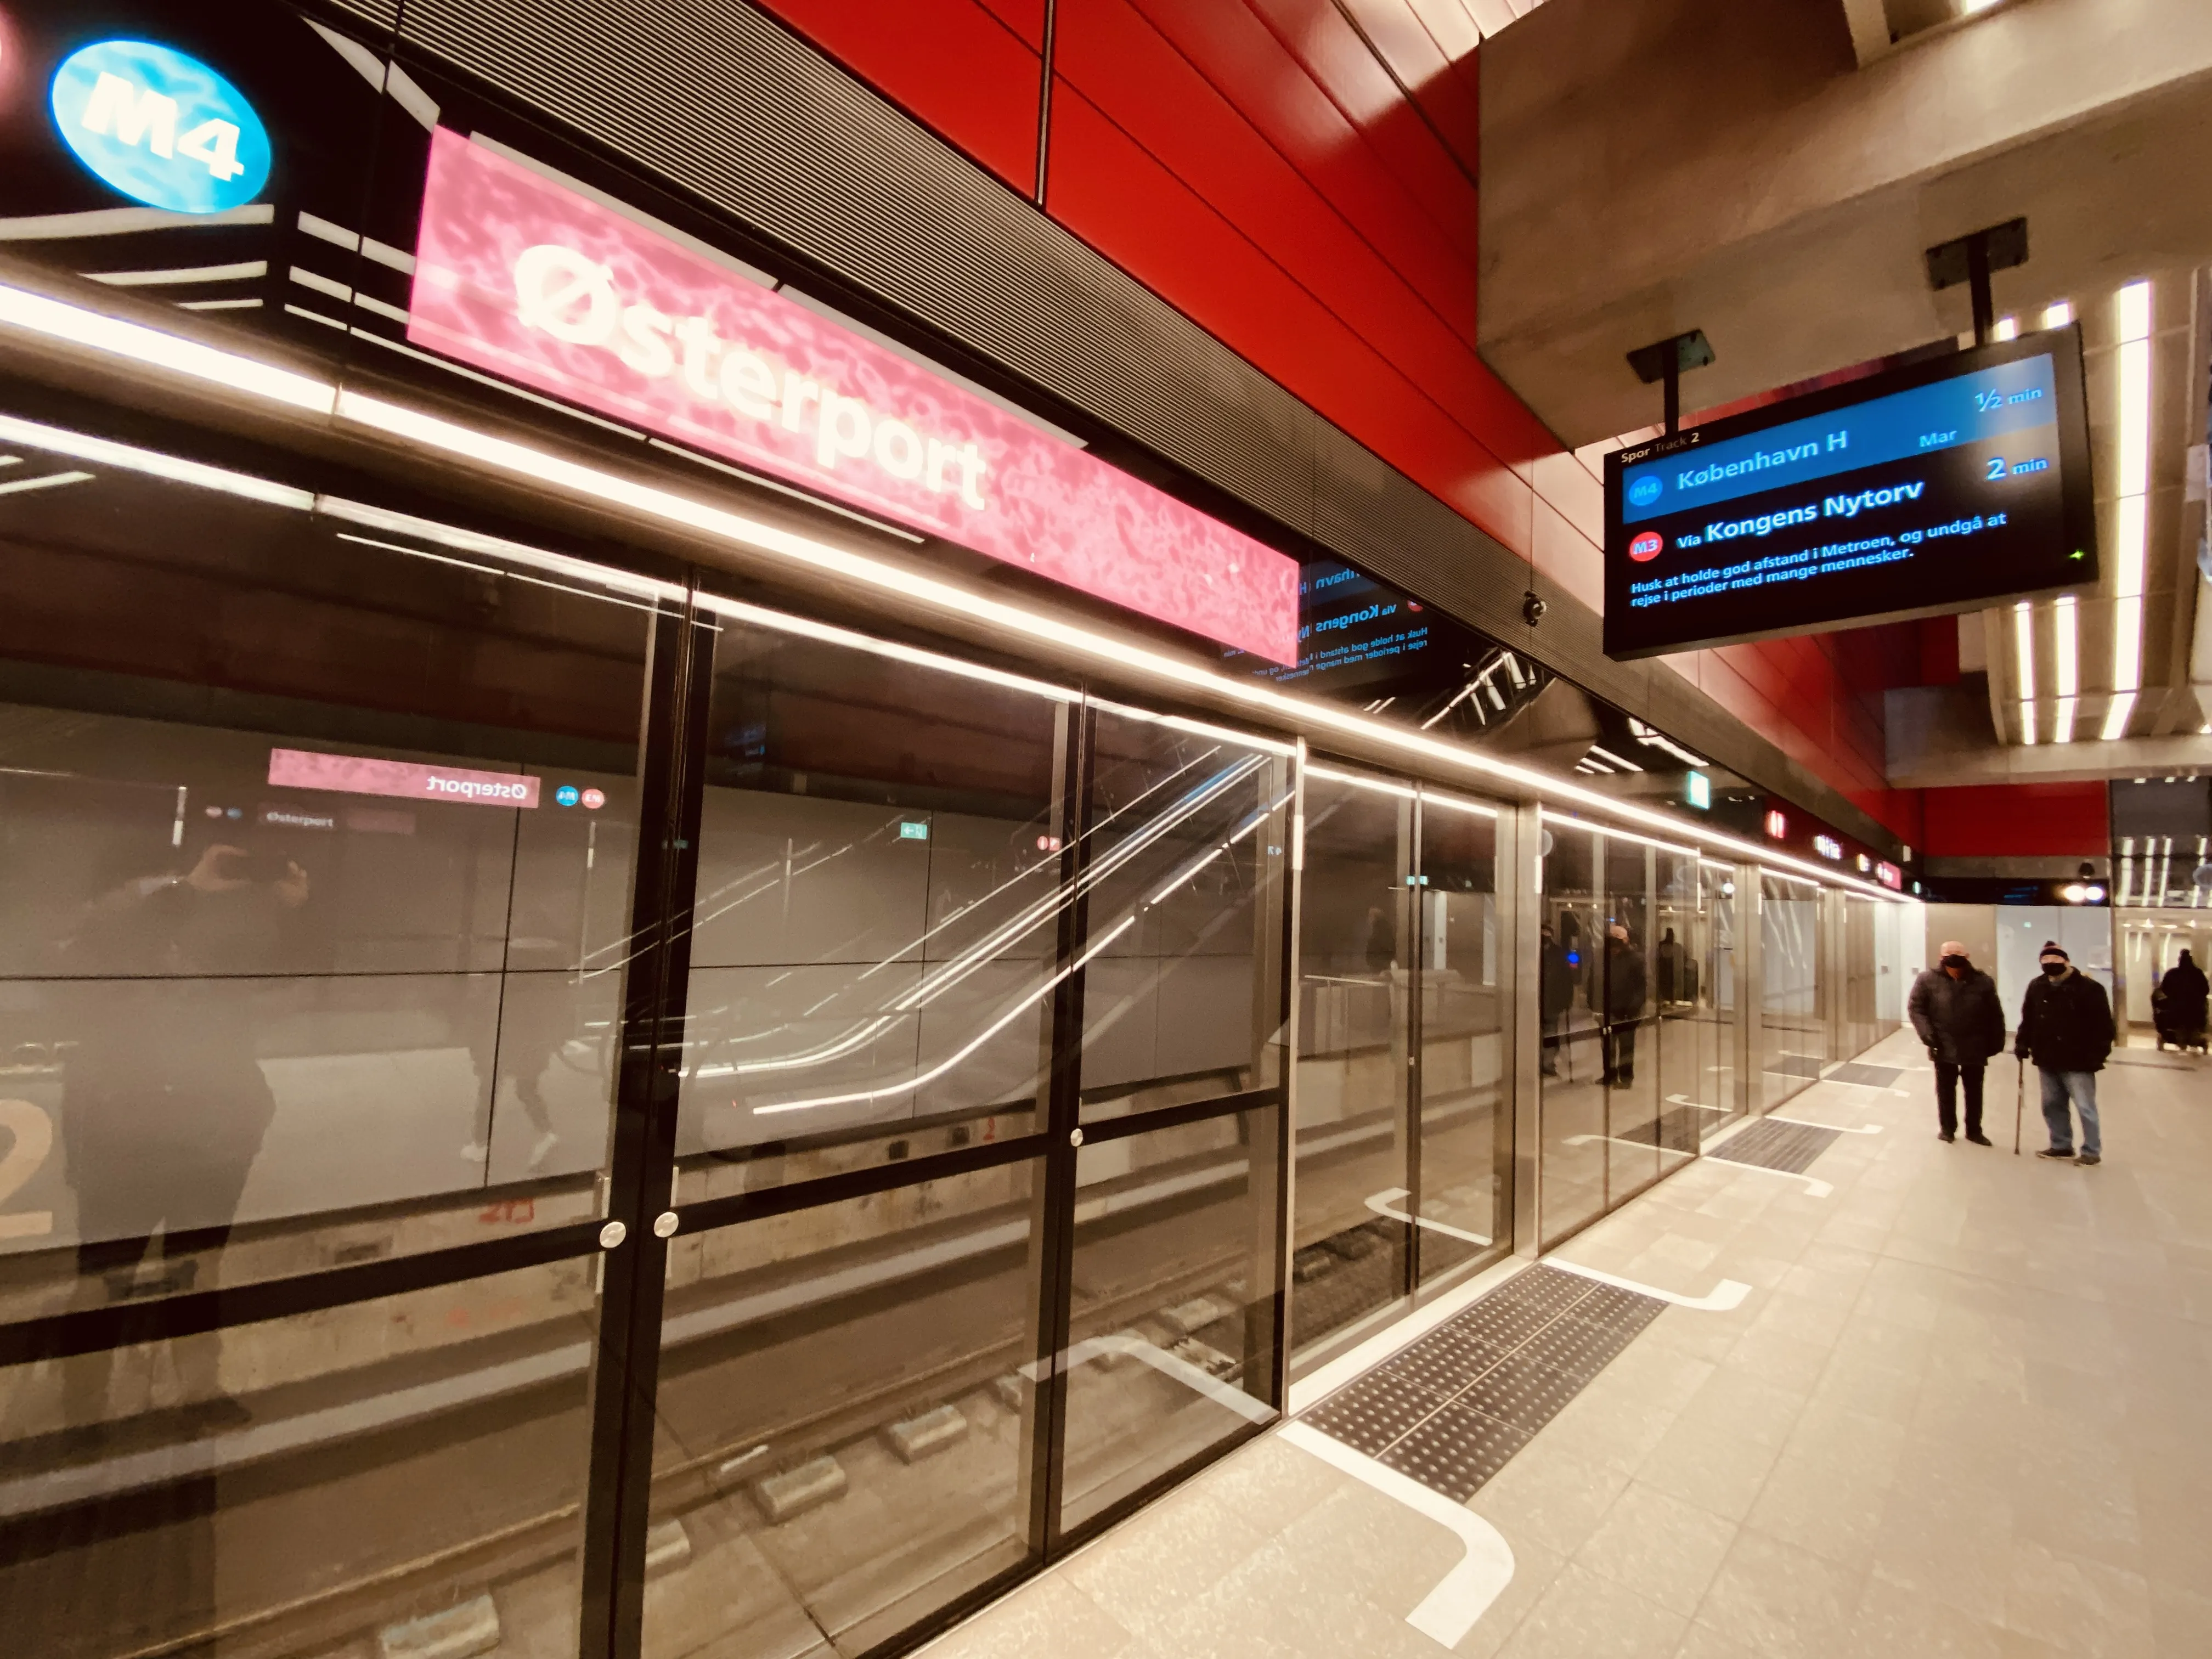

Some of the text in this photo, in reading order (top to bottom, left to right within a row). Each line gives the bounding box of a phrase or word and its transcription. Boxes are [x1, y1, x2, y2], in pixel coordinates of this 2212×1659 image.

[82, 71, 245, 182] M4
[513, 244, 988, 511] Østerport
[2008, 387, 2042, 404] min
[1621, 432, 1700, 463] Spor Track 2
[1633, 430, 1958, 499] M4 København H Mar
[1633, 457, 2048, 555] M3 Via Kongens Nytorv 2 min
[1630, 511, 2007, 594] Husk at holde god afstand i Metroen, og undgå at
[1630, 548, 1915, 607] rejse i perioder med mange mennesker.
